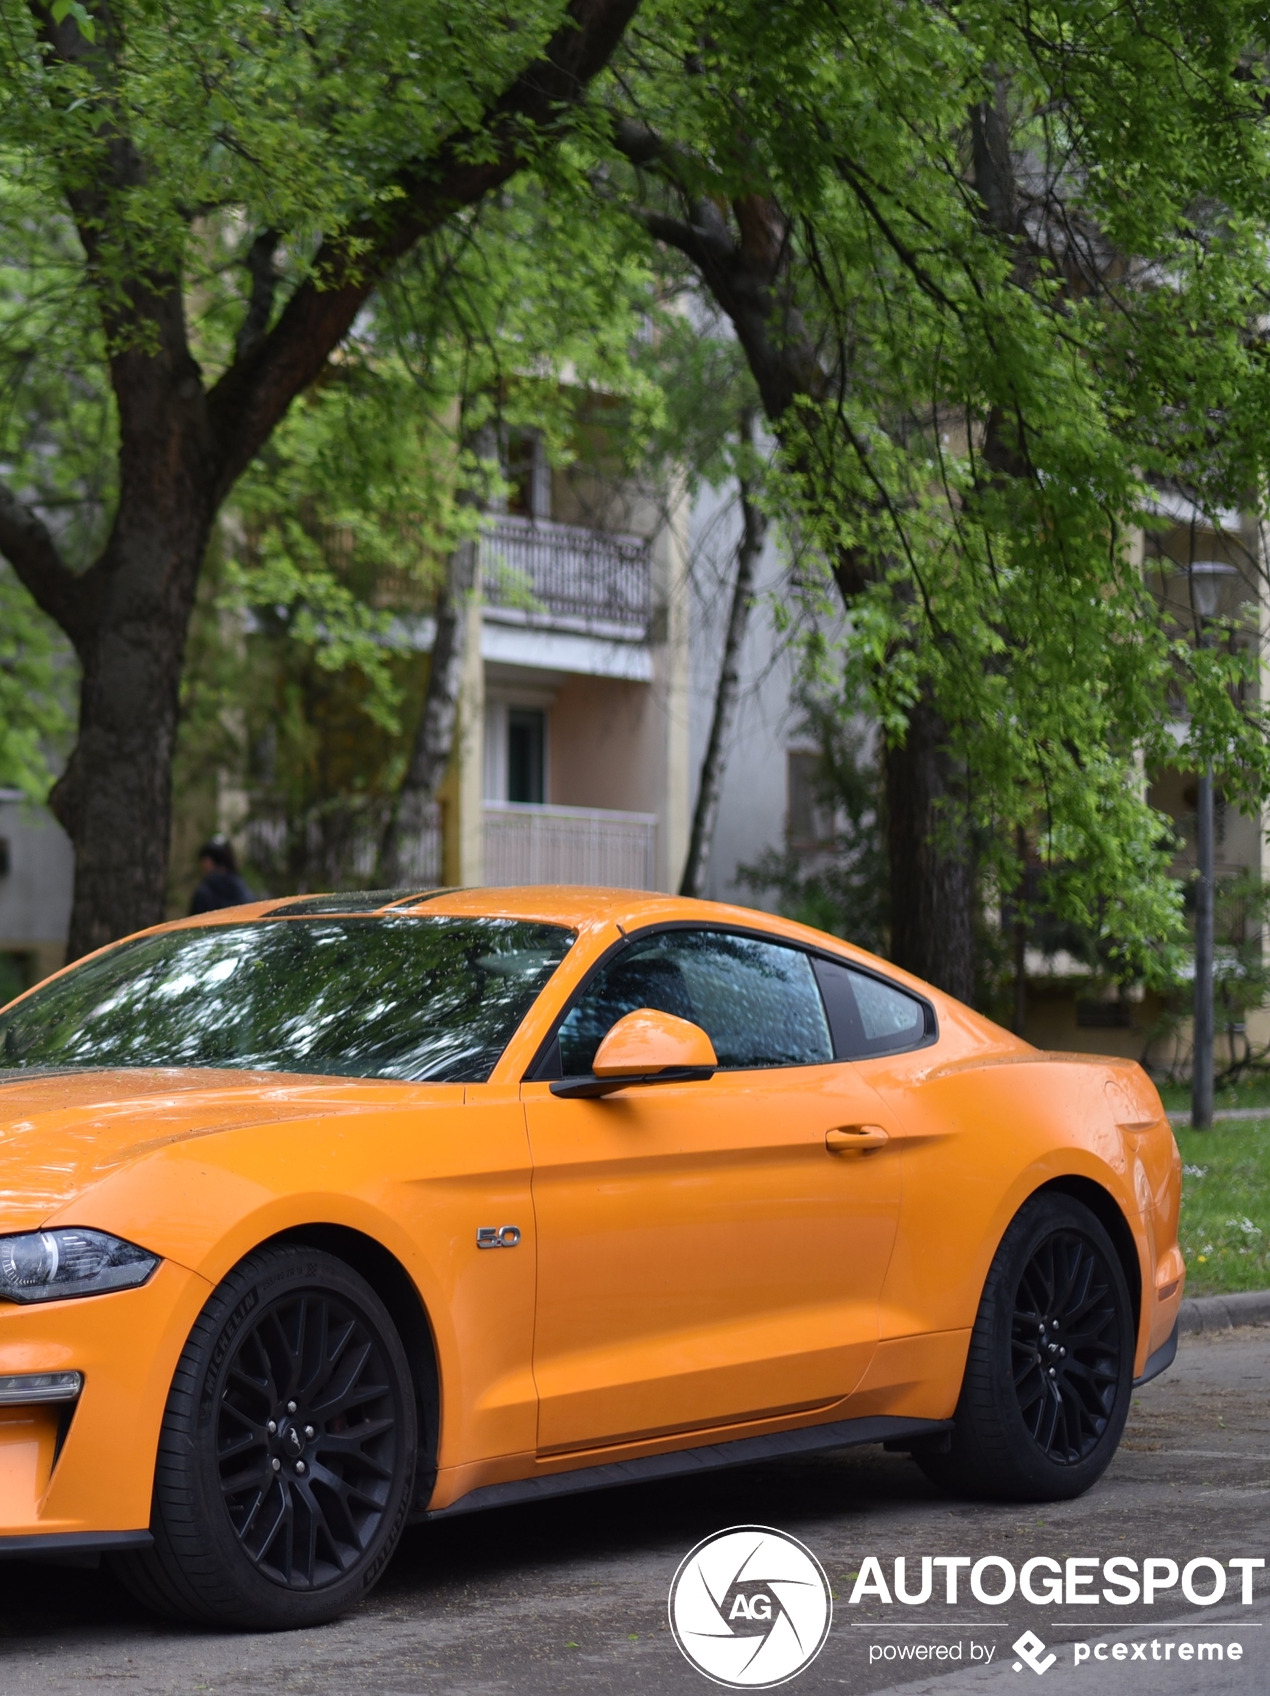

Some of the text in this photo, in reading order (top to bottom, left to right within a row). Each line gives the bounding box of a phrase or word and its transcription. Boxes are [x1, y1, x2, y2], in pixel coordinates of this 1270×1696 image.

[477, 1226, 520, 1249] 5.0
[204, 1291, 256, 1395] MICHELIN
[366, 1483, 409, 1581] MICHELIN
